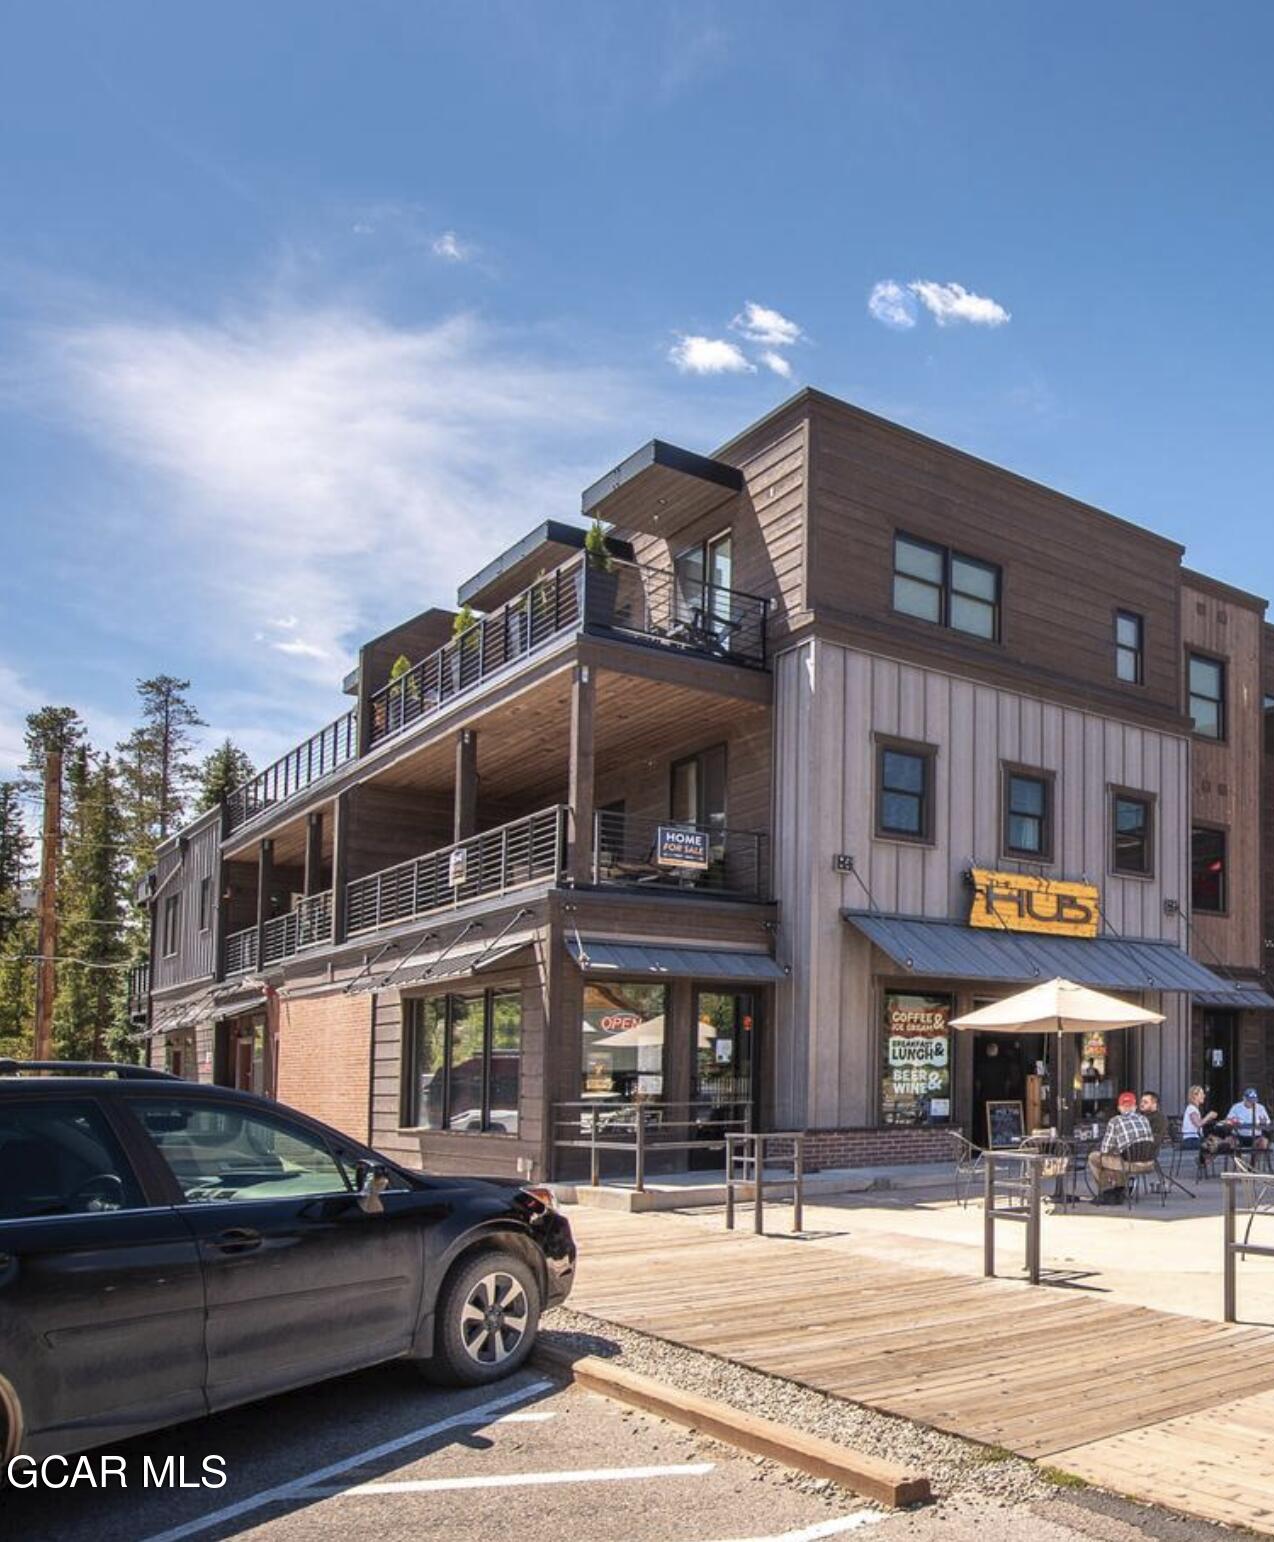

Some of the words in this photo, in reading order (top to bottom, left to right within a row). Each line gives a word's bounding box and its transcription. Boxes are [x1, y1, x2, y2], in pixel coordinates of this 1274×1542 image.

[666, 832, 702, 845] HOME
[985, 885, 1093, 924] HUB
[601, 1016, 642, 1030] OPEN
[892, 1011, 933, 1023] COFFEE
[892, 1048, 934, 1060] LUNCH
[893, 1069, 928, 1081] BEER
[893, 1082, 928, 1095] WINE
